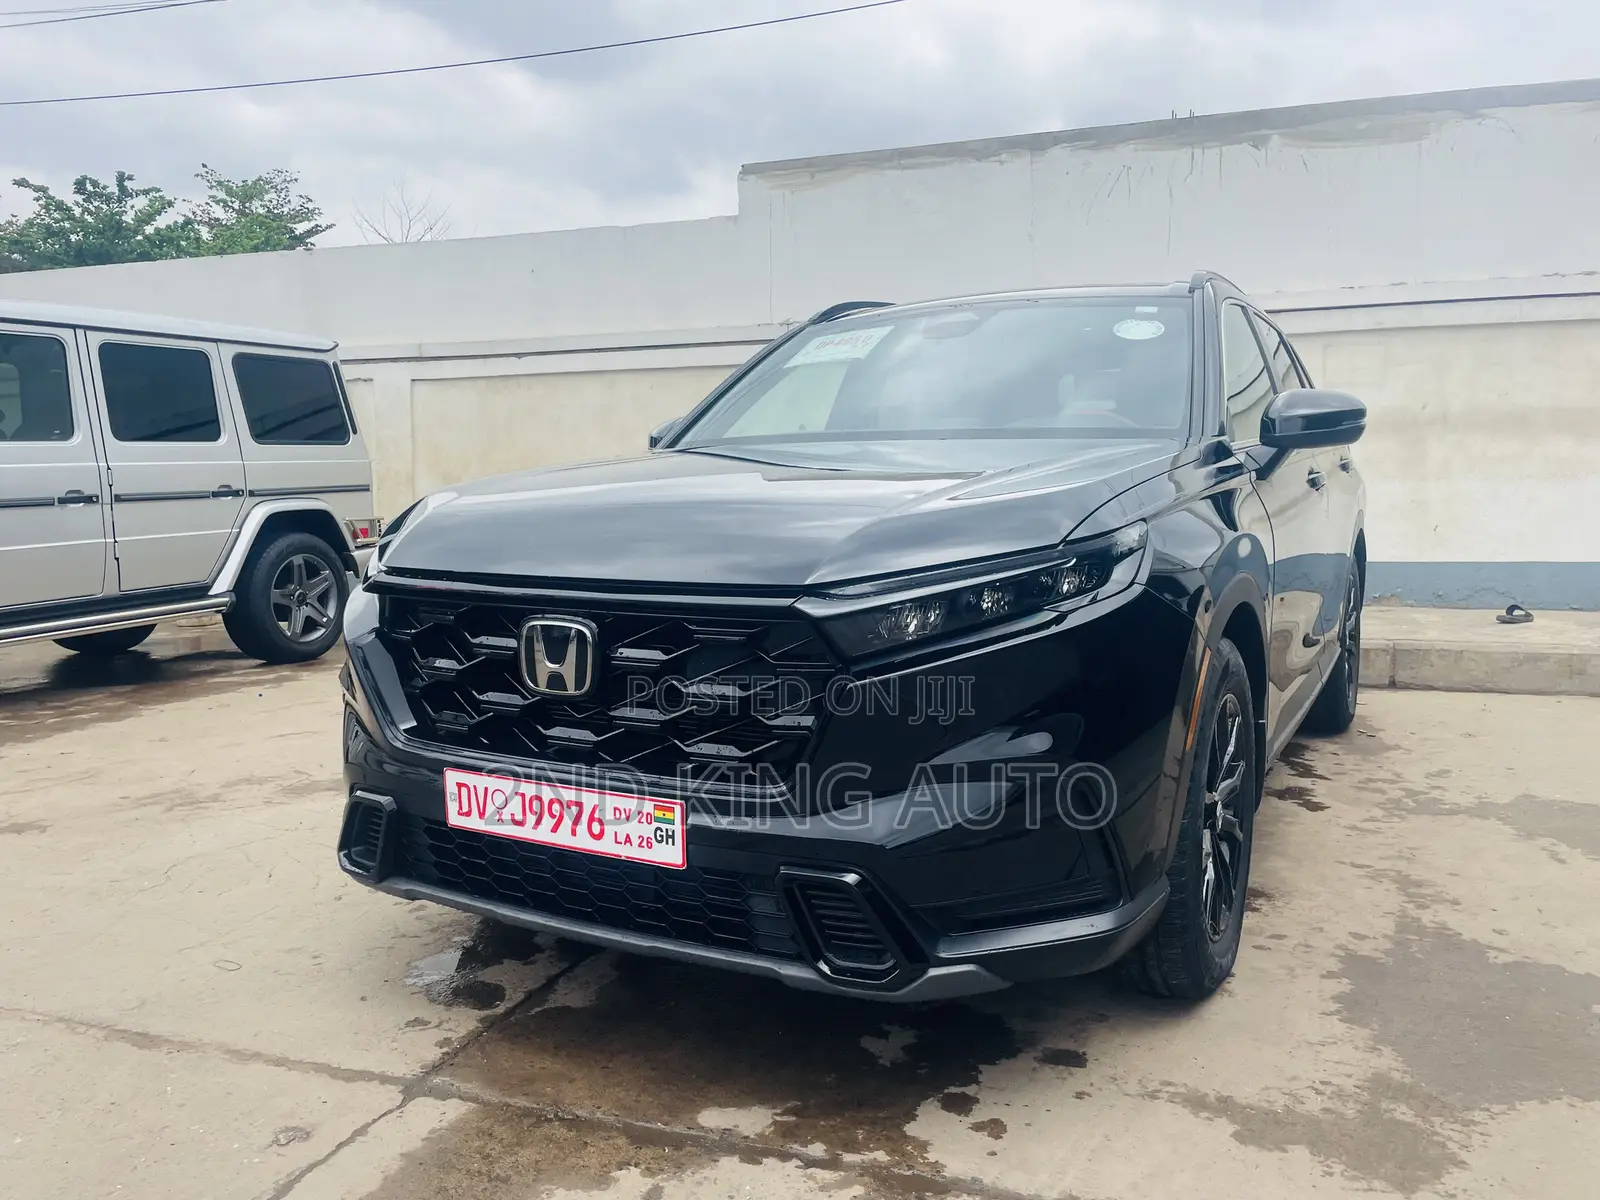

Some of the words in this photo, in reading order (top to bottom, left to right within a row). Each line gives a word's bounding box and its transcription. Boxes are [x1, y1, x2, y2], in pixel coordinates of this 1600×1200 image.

[455, 781, 489, 821] DV
[510, 791, 606, 841] J9976
[613, 806, 632, 822] DV
[637, 810, 653, 825] 20
[614, 830, 633, 847] LA
[637, 834, 653, 850] 26
[653, 826, 676, 847] GH
